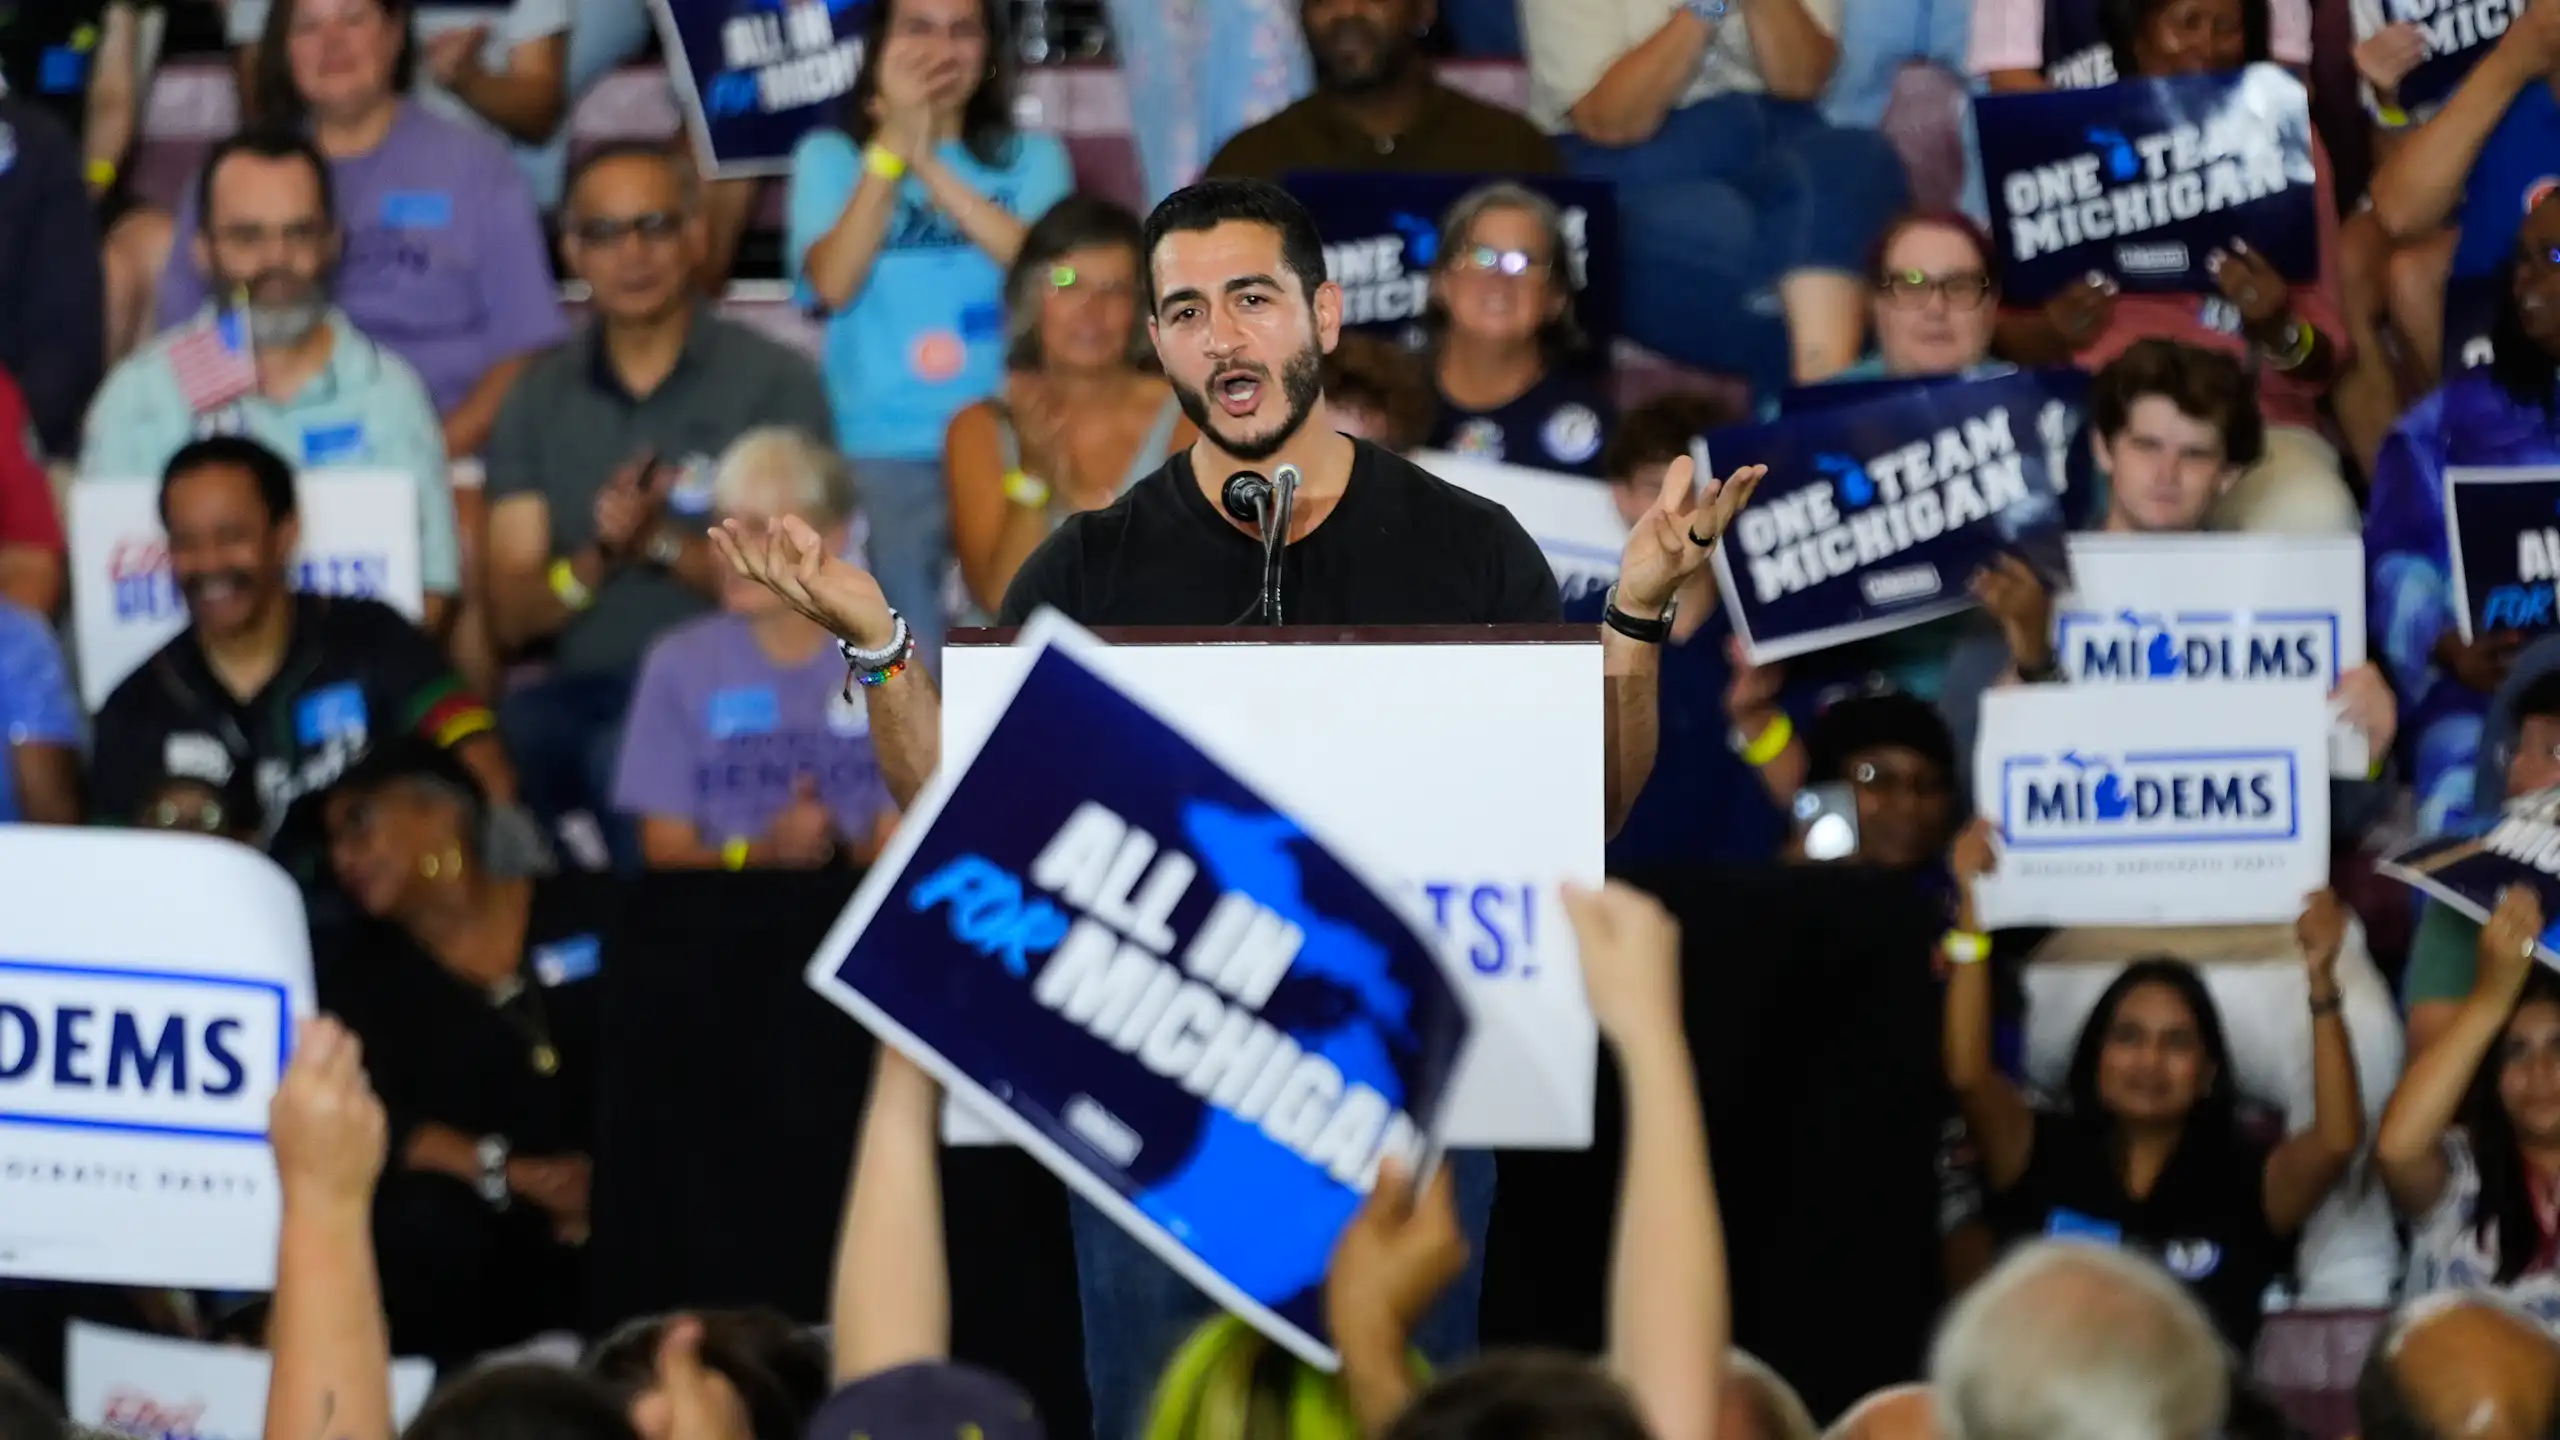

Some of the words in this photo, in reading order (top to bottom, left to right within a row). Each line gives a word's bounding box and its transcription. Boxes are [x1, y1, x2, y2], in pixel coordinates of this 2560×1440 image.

[722, 14, 784, 70] ALL
[2004, 152, 2103, 217] ONE
[2010, 148, 2290, 262] MICHIGAN
[1736, 480, 1841, 556] ONE
[1865, 404, 2016, 500] TEAM
[1749, 450, 2030, 604] MICHIGAN
[2080, 636, 2138, 680] MI
[2480, 584, 2554, 633] FOR
[2025, 781, 2085, 826] MI
[2134, 774, 2276, 822] DEMS
[908, 853, 1072, 980] FOR
[1029, 799, 1197, 956] ALL
[1181, 889, 1306, 1012] IN
[1031, 915, 1430, 1196] MICHIGAN
